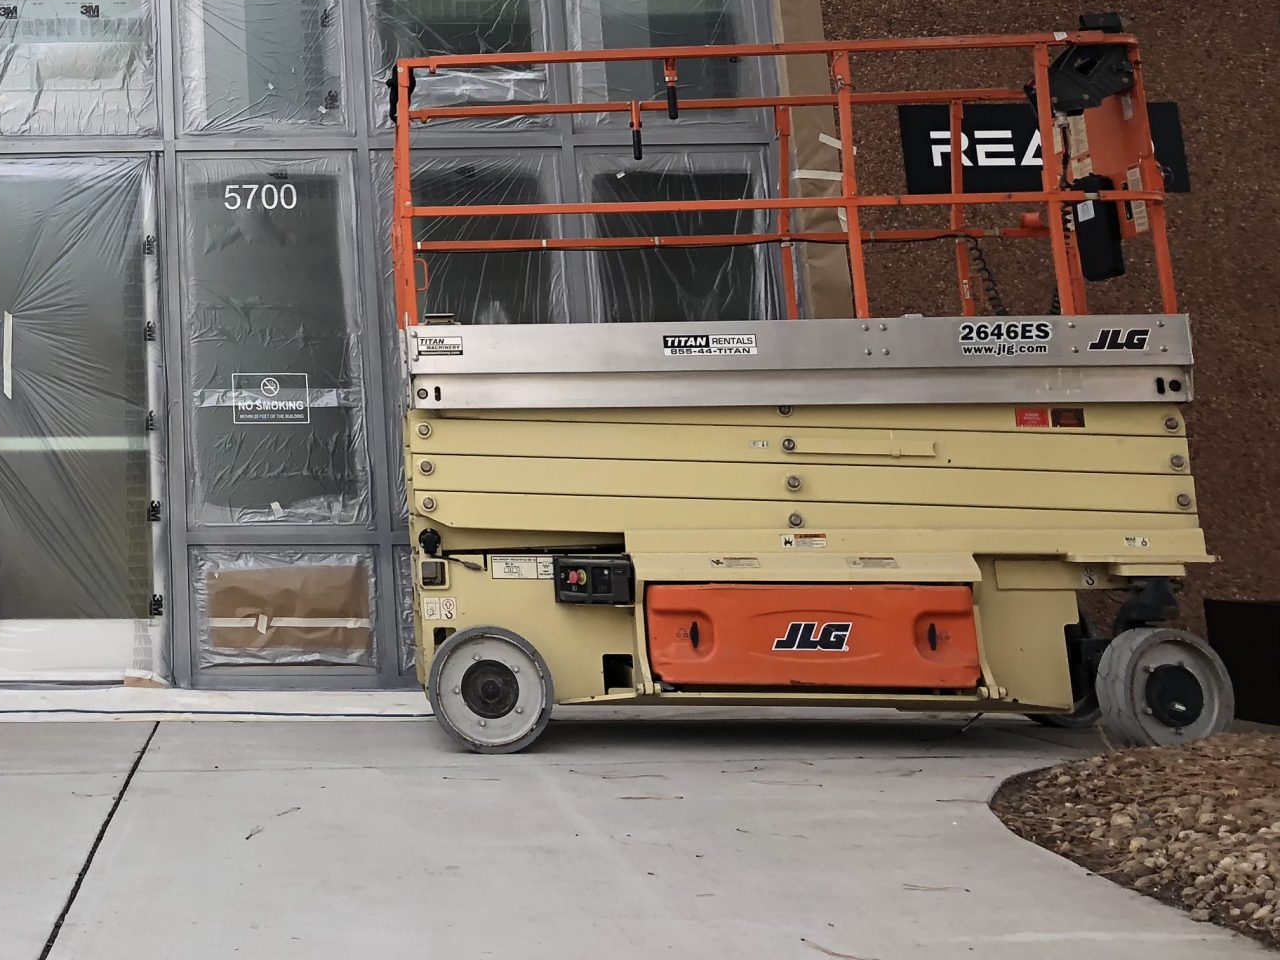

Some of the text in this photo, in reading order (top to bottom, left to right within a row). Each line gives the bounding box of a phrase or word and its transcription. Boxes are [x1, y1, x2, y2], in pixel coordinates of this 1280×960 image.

[0, 6, 18, 16] 3M
[80, 5, 100, 16] 3M
[223, 183, 297, 210] 5700
[147, 320, 157, 341] 3M
[960, 323, 1050, 341] 2646ES
[1088, 329, 1150, 351] JLG
[666, 337, 753, 347] TITAN RENTALS
[963, 344, 1048, 356] www.jlg.com
[238, 400, 304, 411] NO SMOKING
[151, 500, 162, 522] 3M
[152, 594, 164, 616] 3M
[772, 621, 853, 651] JLG
